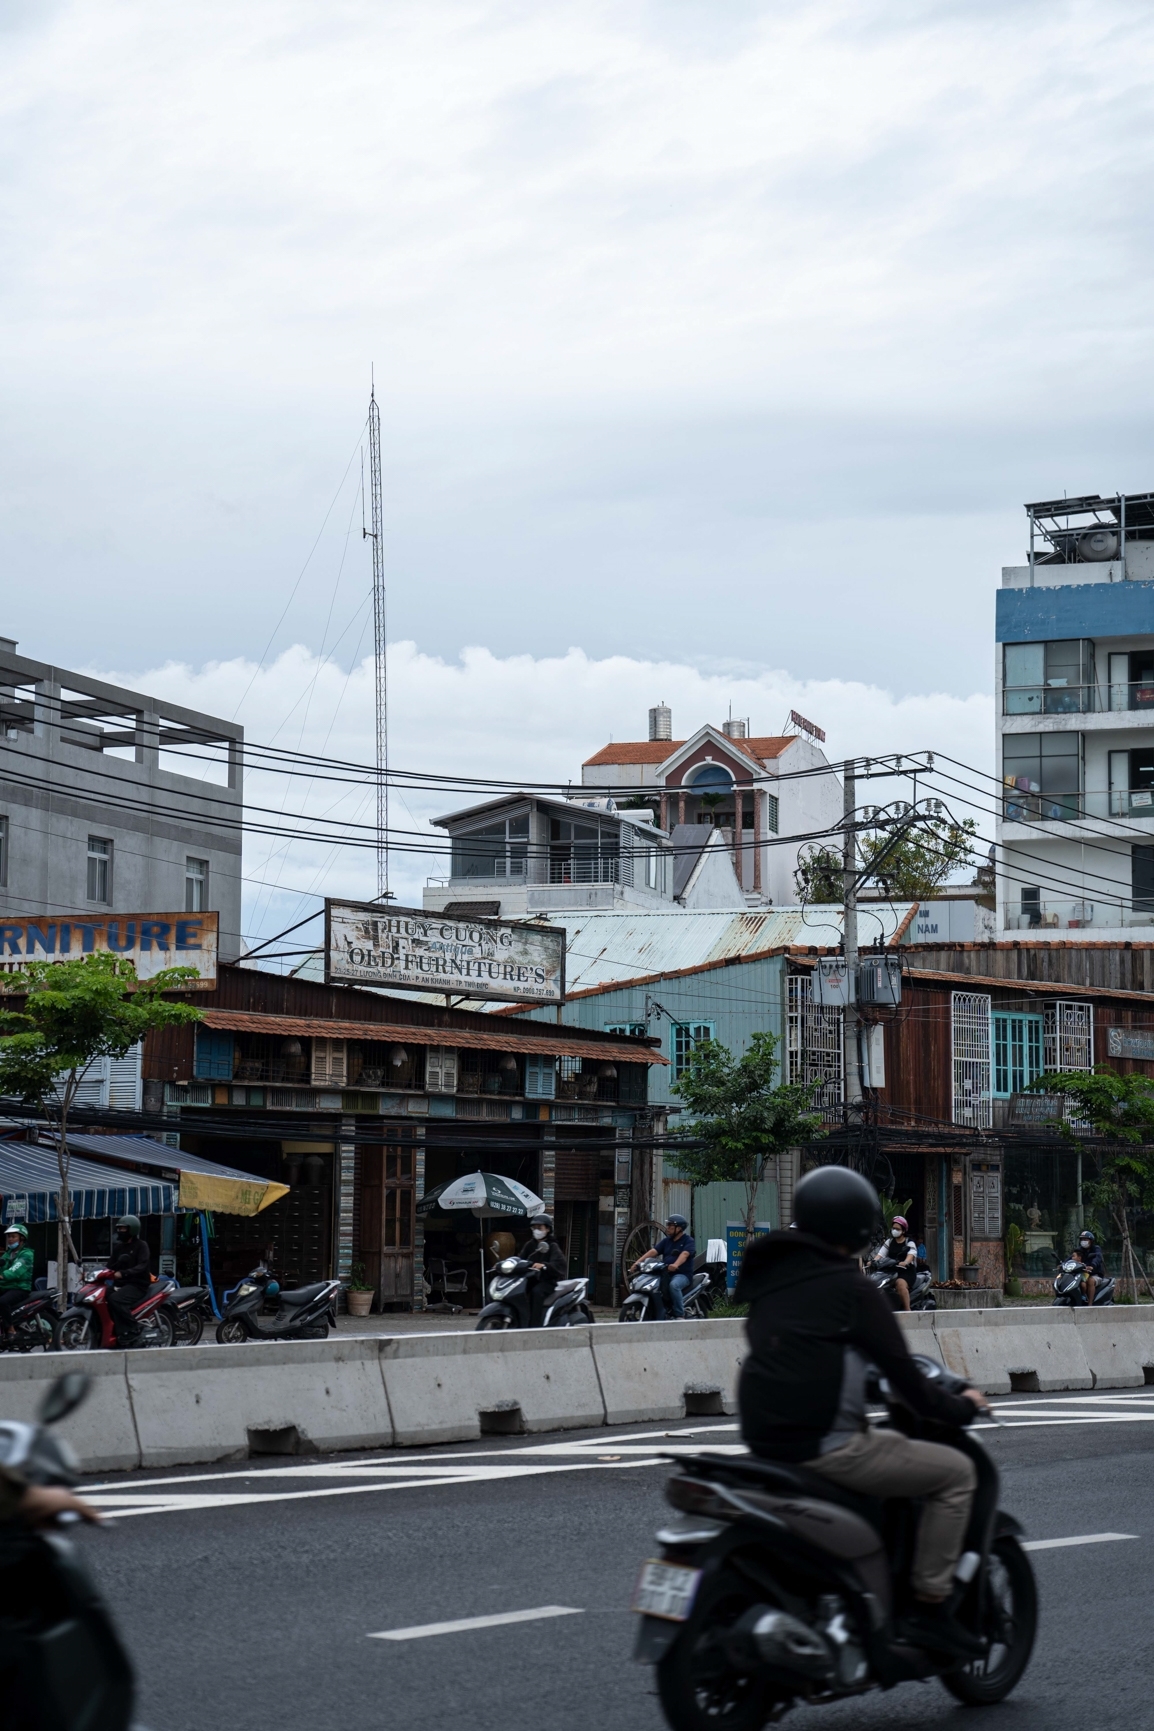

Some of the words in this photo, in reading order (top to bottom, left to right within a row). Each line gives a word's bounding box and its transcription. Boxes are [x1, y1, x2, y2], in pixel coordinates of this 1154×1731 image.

[917, 923, 939, 934] NAM
[0, 919, 203, 956] RNITURE
[428, 941, 474, 957] Antique
[349, 947, 396, 969] OLD
[403, 953, 546, 985] FURNITURE'S
[421, 976, 430, 984] AN
